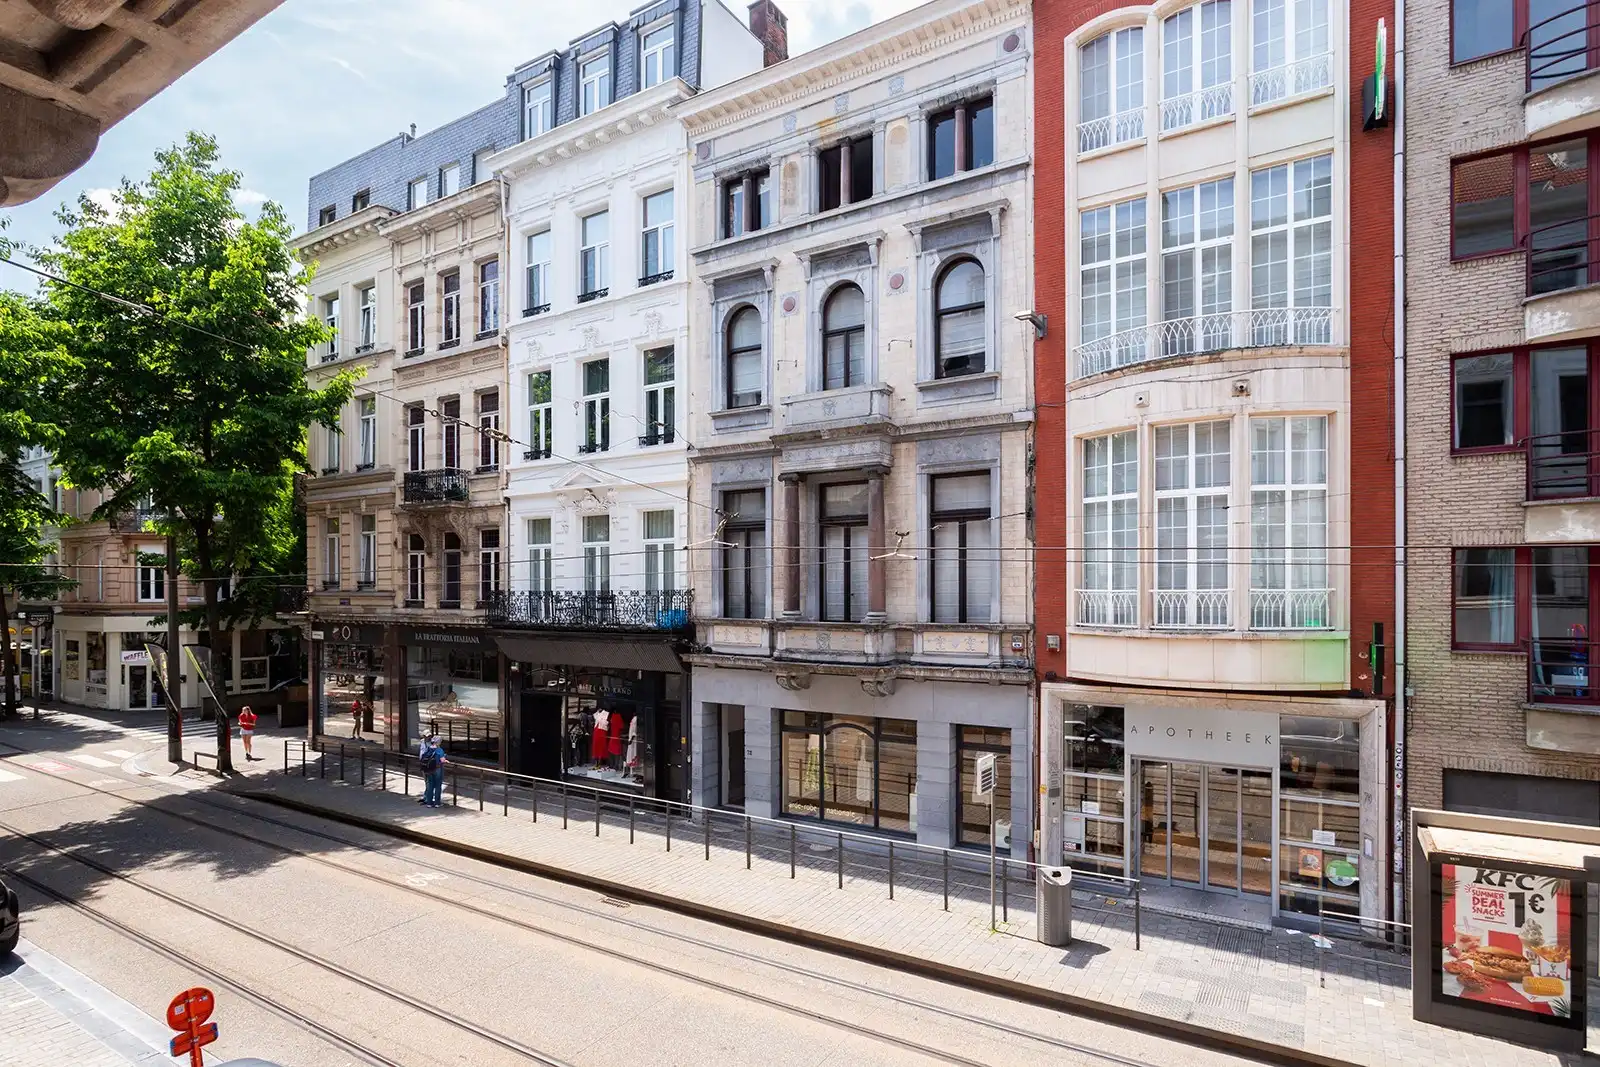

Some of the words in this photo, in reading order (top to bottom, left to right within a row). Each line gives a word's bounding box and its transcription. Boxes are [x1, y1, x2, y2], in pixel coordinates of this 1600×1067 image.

[454, 634, 481, 645] ITALIANA
[1130, 724, 1273, 745] APOTHEEK
[1473, 868, 1535, 891] KFC
[1471, 889, 1505, 900] SUMMER
[1472, 897, 1506, 910] DEAL
[1471, 906, 1505, 918] SNACKS
